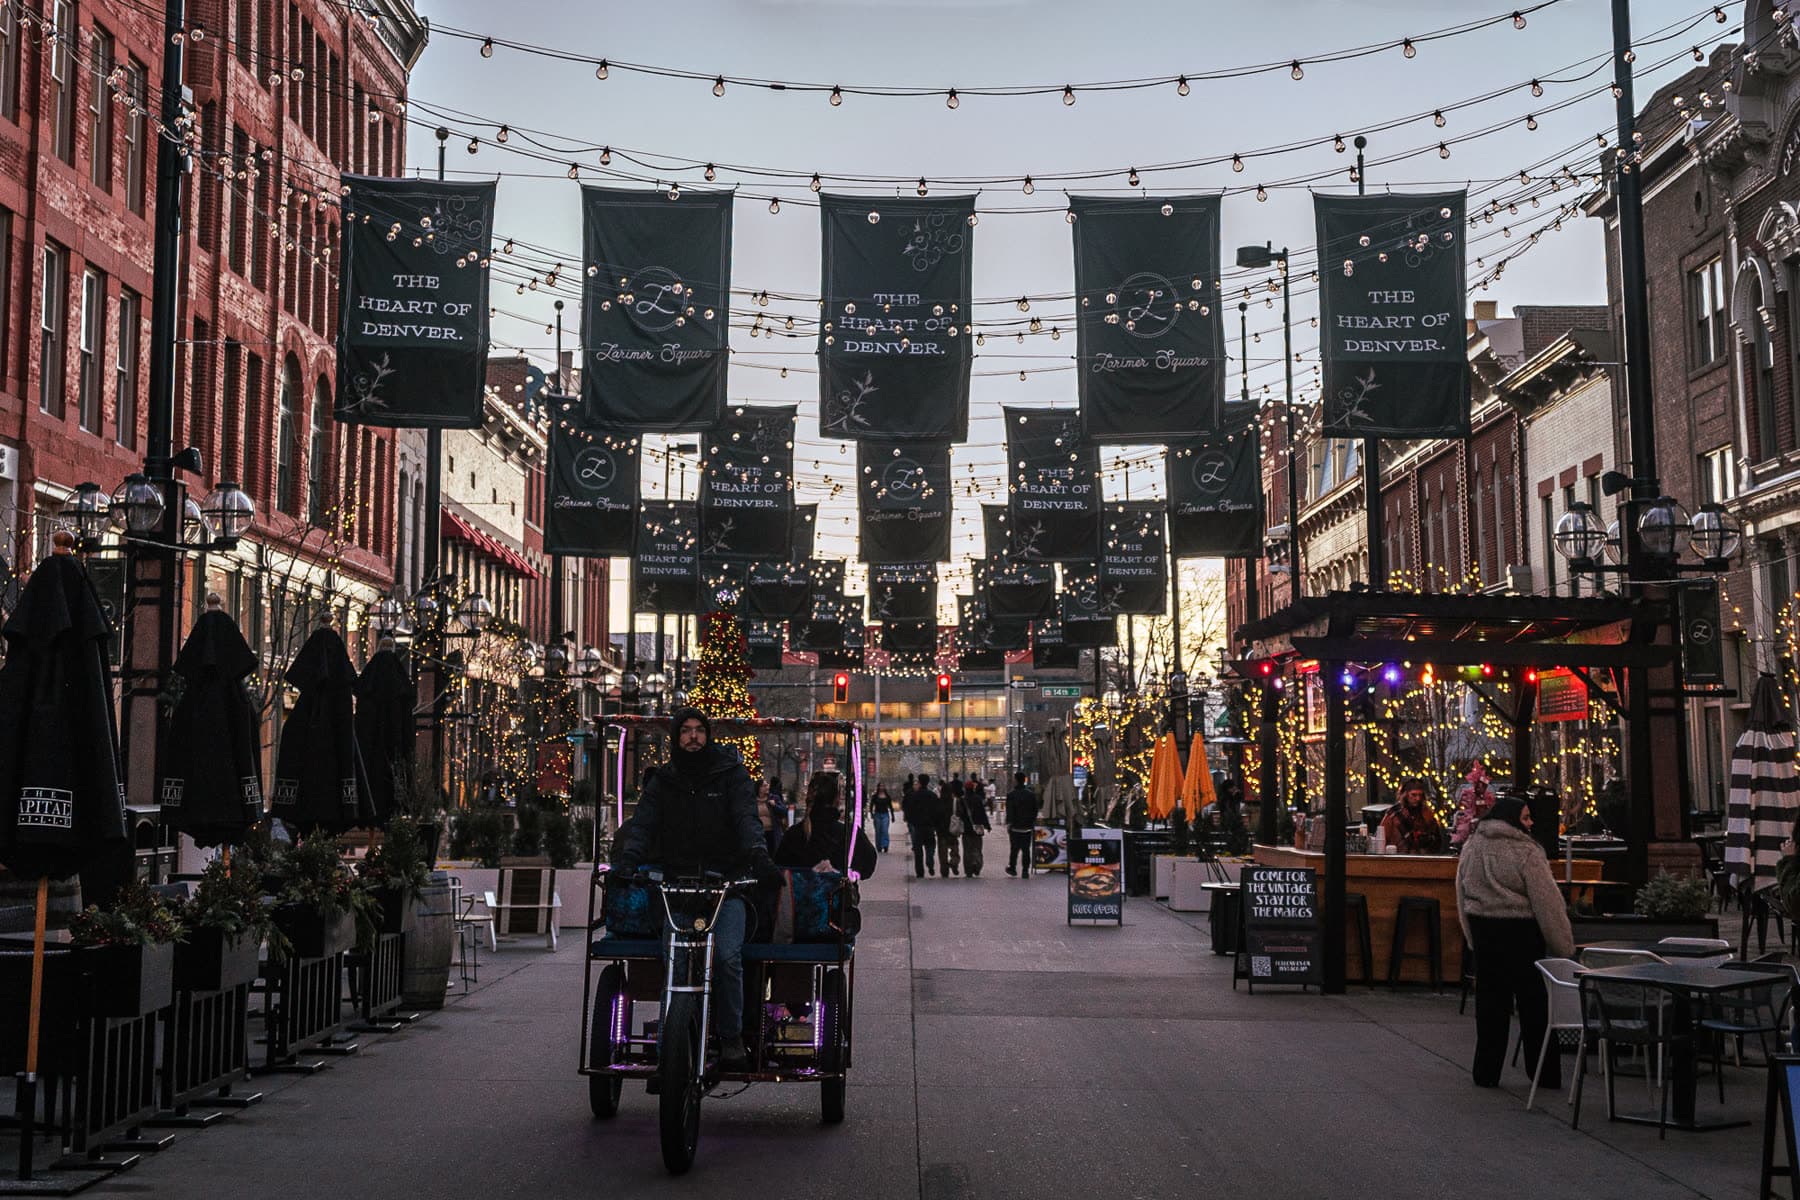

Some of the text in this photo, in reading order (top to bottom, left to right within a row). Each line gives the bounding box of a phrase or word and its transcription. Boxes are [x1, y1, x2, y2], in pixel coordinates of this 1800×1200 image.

[392, 274, 440, 289] THE
[873, 293, 920, 306] THE
[1368, 290, 1415, 304] THE
[358, 295, 472, 316] HEART OF
[839, 316, 953, 331] HEART OF
[1336, 312, 1450, 329] HEART OF
[361, 322, 464, 341] DENVER.
[843, 340, 946, 355] DENVER.
[1344, 338, 1446, 352] DENVER.
[596, 342, 712, 366] Larimer Square
[1092, 349, 1208, 373] Larimer Square
[731, 466, 762, 477] THE
[710, 481, 783, 493] HEART OF
[1072, 484, 1092, 494] OF
[554, 495, 631, 512] Larimer Square
[713, 497, 779, 508] DENVER.
[1023, 499, 1088, 510] DENVER.
[655, 543, 678, 551] THE
[640, 553, 694, 564] HEART OF
[1105, 555, 1159, 563] HEART OF
[1108, 567, 1157, 575] DENVER.
[22, 790, 57, 799] THE
[1253, 870, 1307, 882] COME FOR
[1246, 882, 1267, 894] THE
[1255, 895, 1308, 906] STAY FOR
[1252, 907, 1313, 918] THE MARGS
